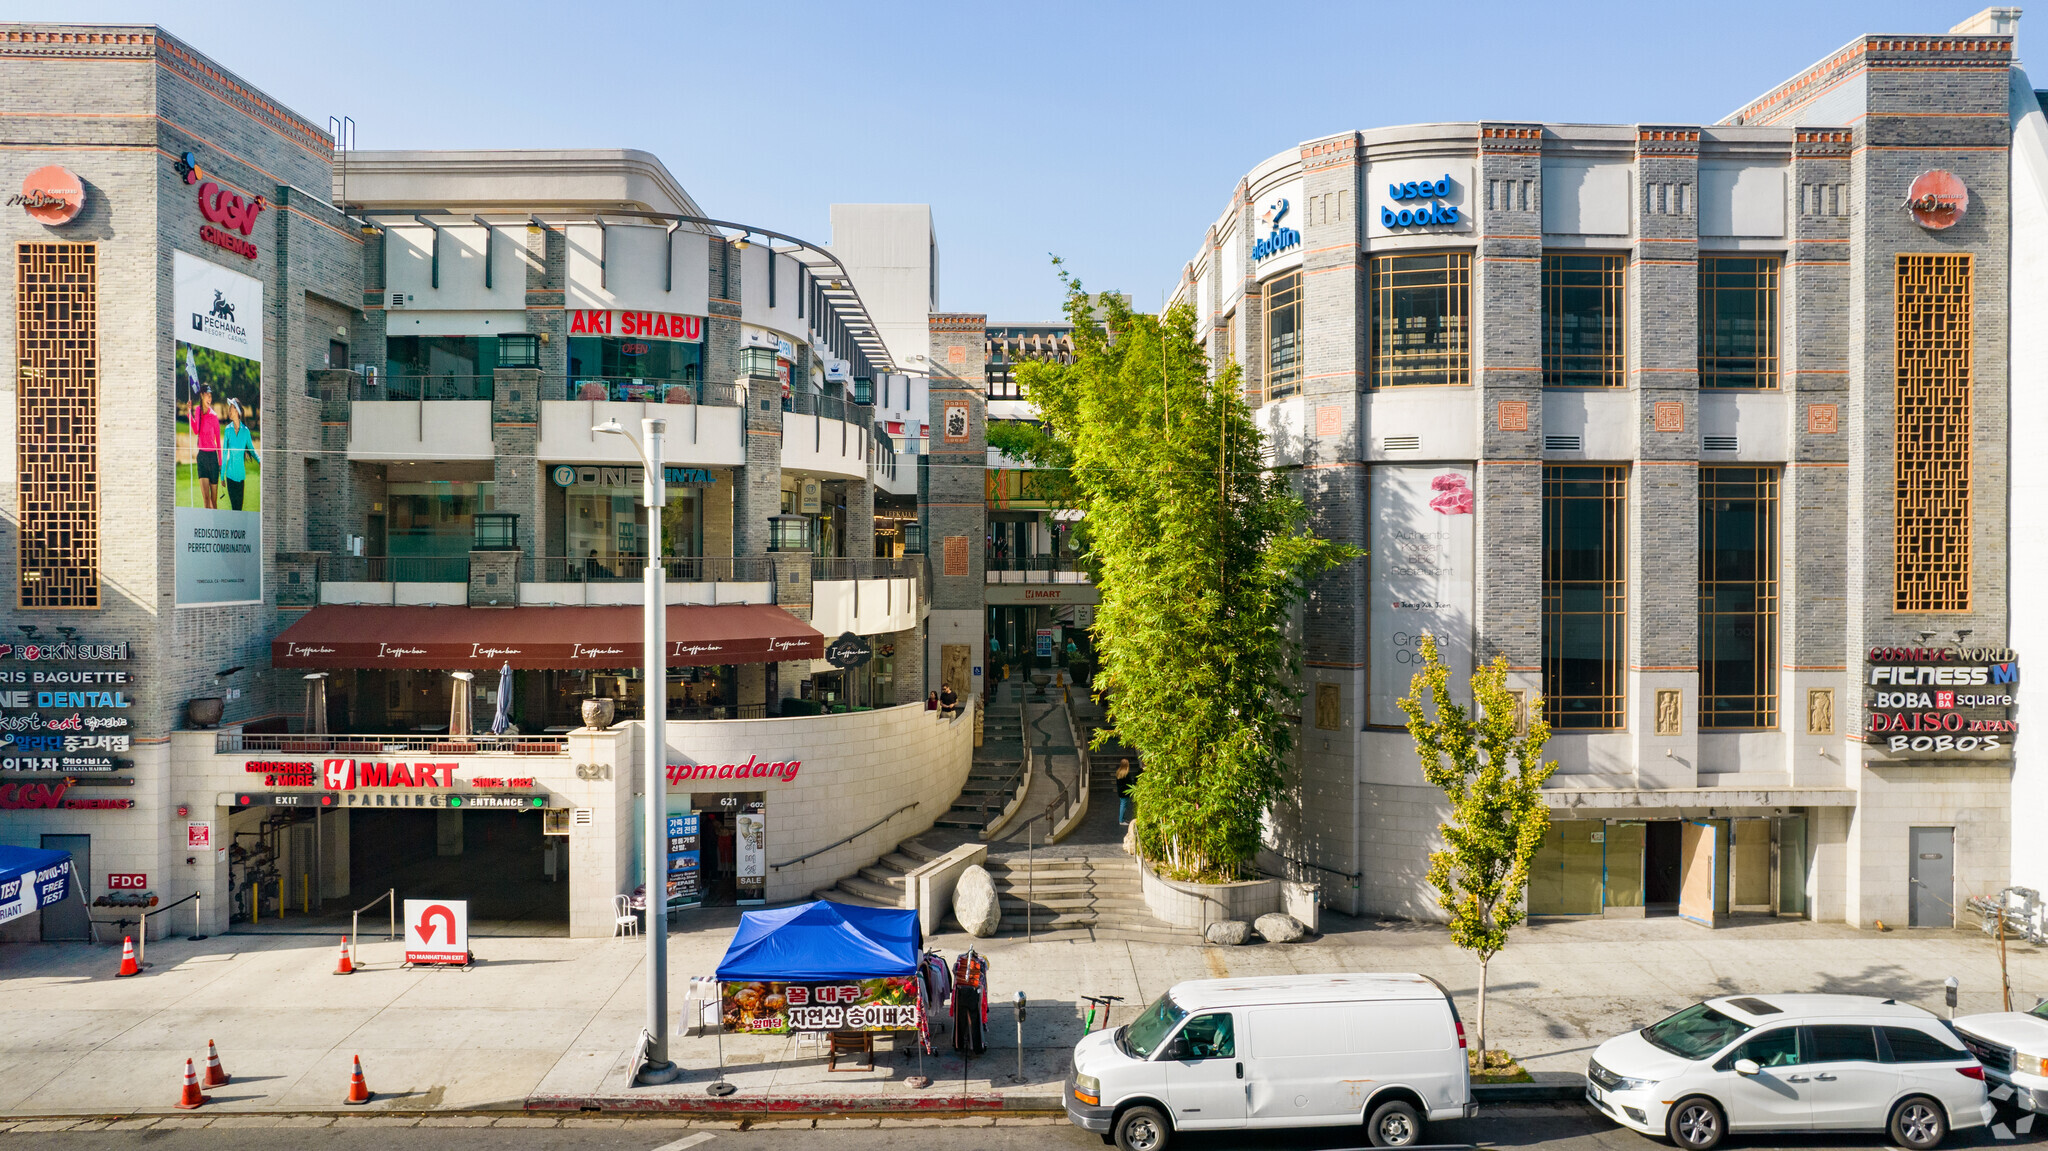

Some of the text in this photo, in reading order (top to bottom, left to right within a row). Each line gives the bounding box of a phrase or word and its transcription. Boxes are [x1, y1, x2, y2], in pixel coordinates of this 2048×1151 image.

[1390, 174, 1450, 200] used
[199, 183, 259, 236] CGV
[1381, 202, 1459, 229] books
[200, 225, 257, 260] CINEMAS
[1251, 227, 1300, 261] aladdin
[204, 316, 247, 337] PECHANGA
[204, 327, 225, 338] RESORT
[570, 310, 700, 340] AKI SHABU
[622, 343, 648, 354] OPEN
[779, 339, 791, 356] OPEN
[578, 467, 717, 488] ONE ENTAL
[194, 528, 246, 540] REDISCOVER YOUR
[1395, 530, 1451, 541] Authentic
[188, 543, 251, 554] PERFECT COMBINATION
[1401, 542, 1444, 553] Korean
[1408, 554, 1436, 565] BBQ
[1391, 565, 1454, 576] Restaurant
[1035, 590, 1061, 598] MART
[1870, 647, 2017, 662] COSMETIC WORLD
[34, 672, 126, 683] BAGUETTE
[38, 692, 127, 708] DENTAL
[1878, 692, 2012, 709] BOBA square
[1871, 712, 2017, 732] DAISO JAPAN
[1889, 735, 2001, 753] BOBO'S
[245, 762, 313, 774] GROCERIES
[325, 758, 459, 791] H MART
[576, 763, 611, 780] 621
[666, 754, 801, 786] apmadang
[264, 775, 314, 787] & MORE
[472, 777, 534, 788] SINCE 1982
[0, 783, 129, 810] CGV CINEMAS
[275, 797, 298, 805] EXIT
[347, 794, 440, 806] PARKING
[470, 797, 524, 807] ENTRANCE
[720, 798, 738, 806] 621
[36, 861, 69, 883] COVID-19
[42, 878, 65, 895] FREE
[110, 875, 145, 887] FDC
[740, 877, 762, 885] SALE
[1, 880, 20, 900] TEST
[42, 890, 64, 906] TEST
[786, 986, 861, 1005] 꿀 대추
[752, 1019, 783, 1029] 앞마당
[788, 1005, 917, 1028] 자연산 송이버섯
